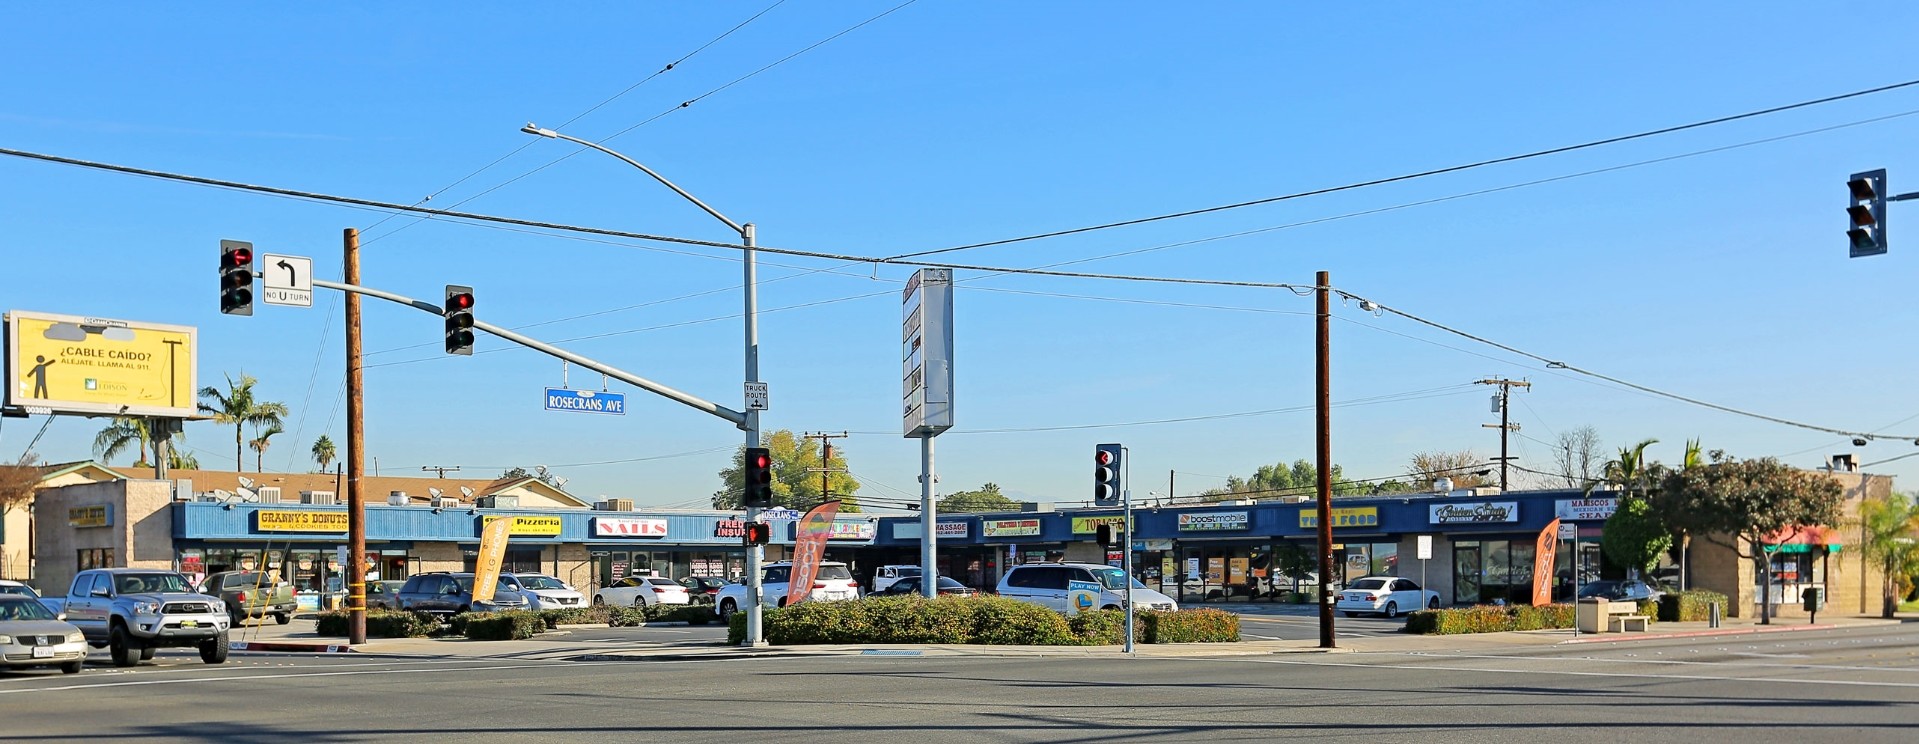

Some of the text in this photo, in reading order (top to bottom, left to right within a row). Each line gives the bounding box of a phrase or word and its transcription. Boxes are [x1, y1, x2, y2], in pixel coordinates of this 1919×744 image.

[279, 291, 287, 301] U
[290, 293, 309, 302] TURN
[60, 346, 152, 362] ¿CABLE CAÍDO?
[98, 361, 124, 369] LLAMA
[549, 395, 622, 412] ROSECRANS AVE
[261, 512, 348, 524] GRANNY'S DONUTS
[517, 518, 560, 526] Pizzeria
[1341, 514, 1377, 525] FOOD
[600, 523, 666, 534] NAILS
[480, 520, 506, 597] FREE LG PHONES
